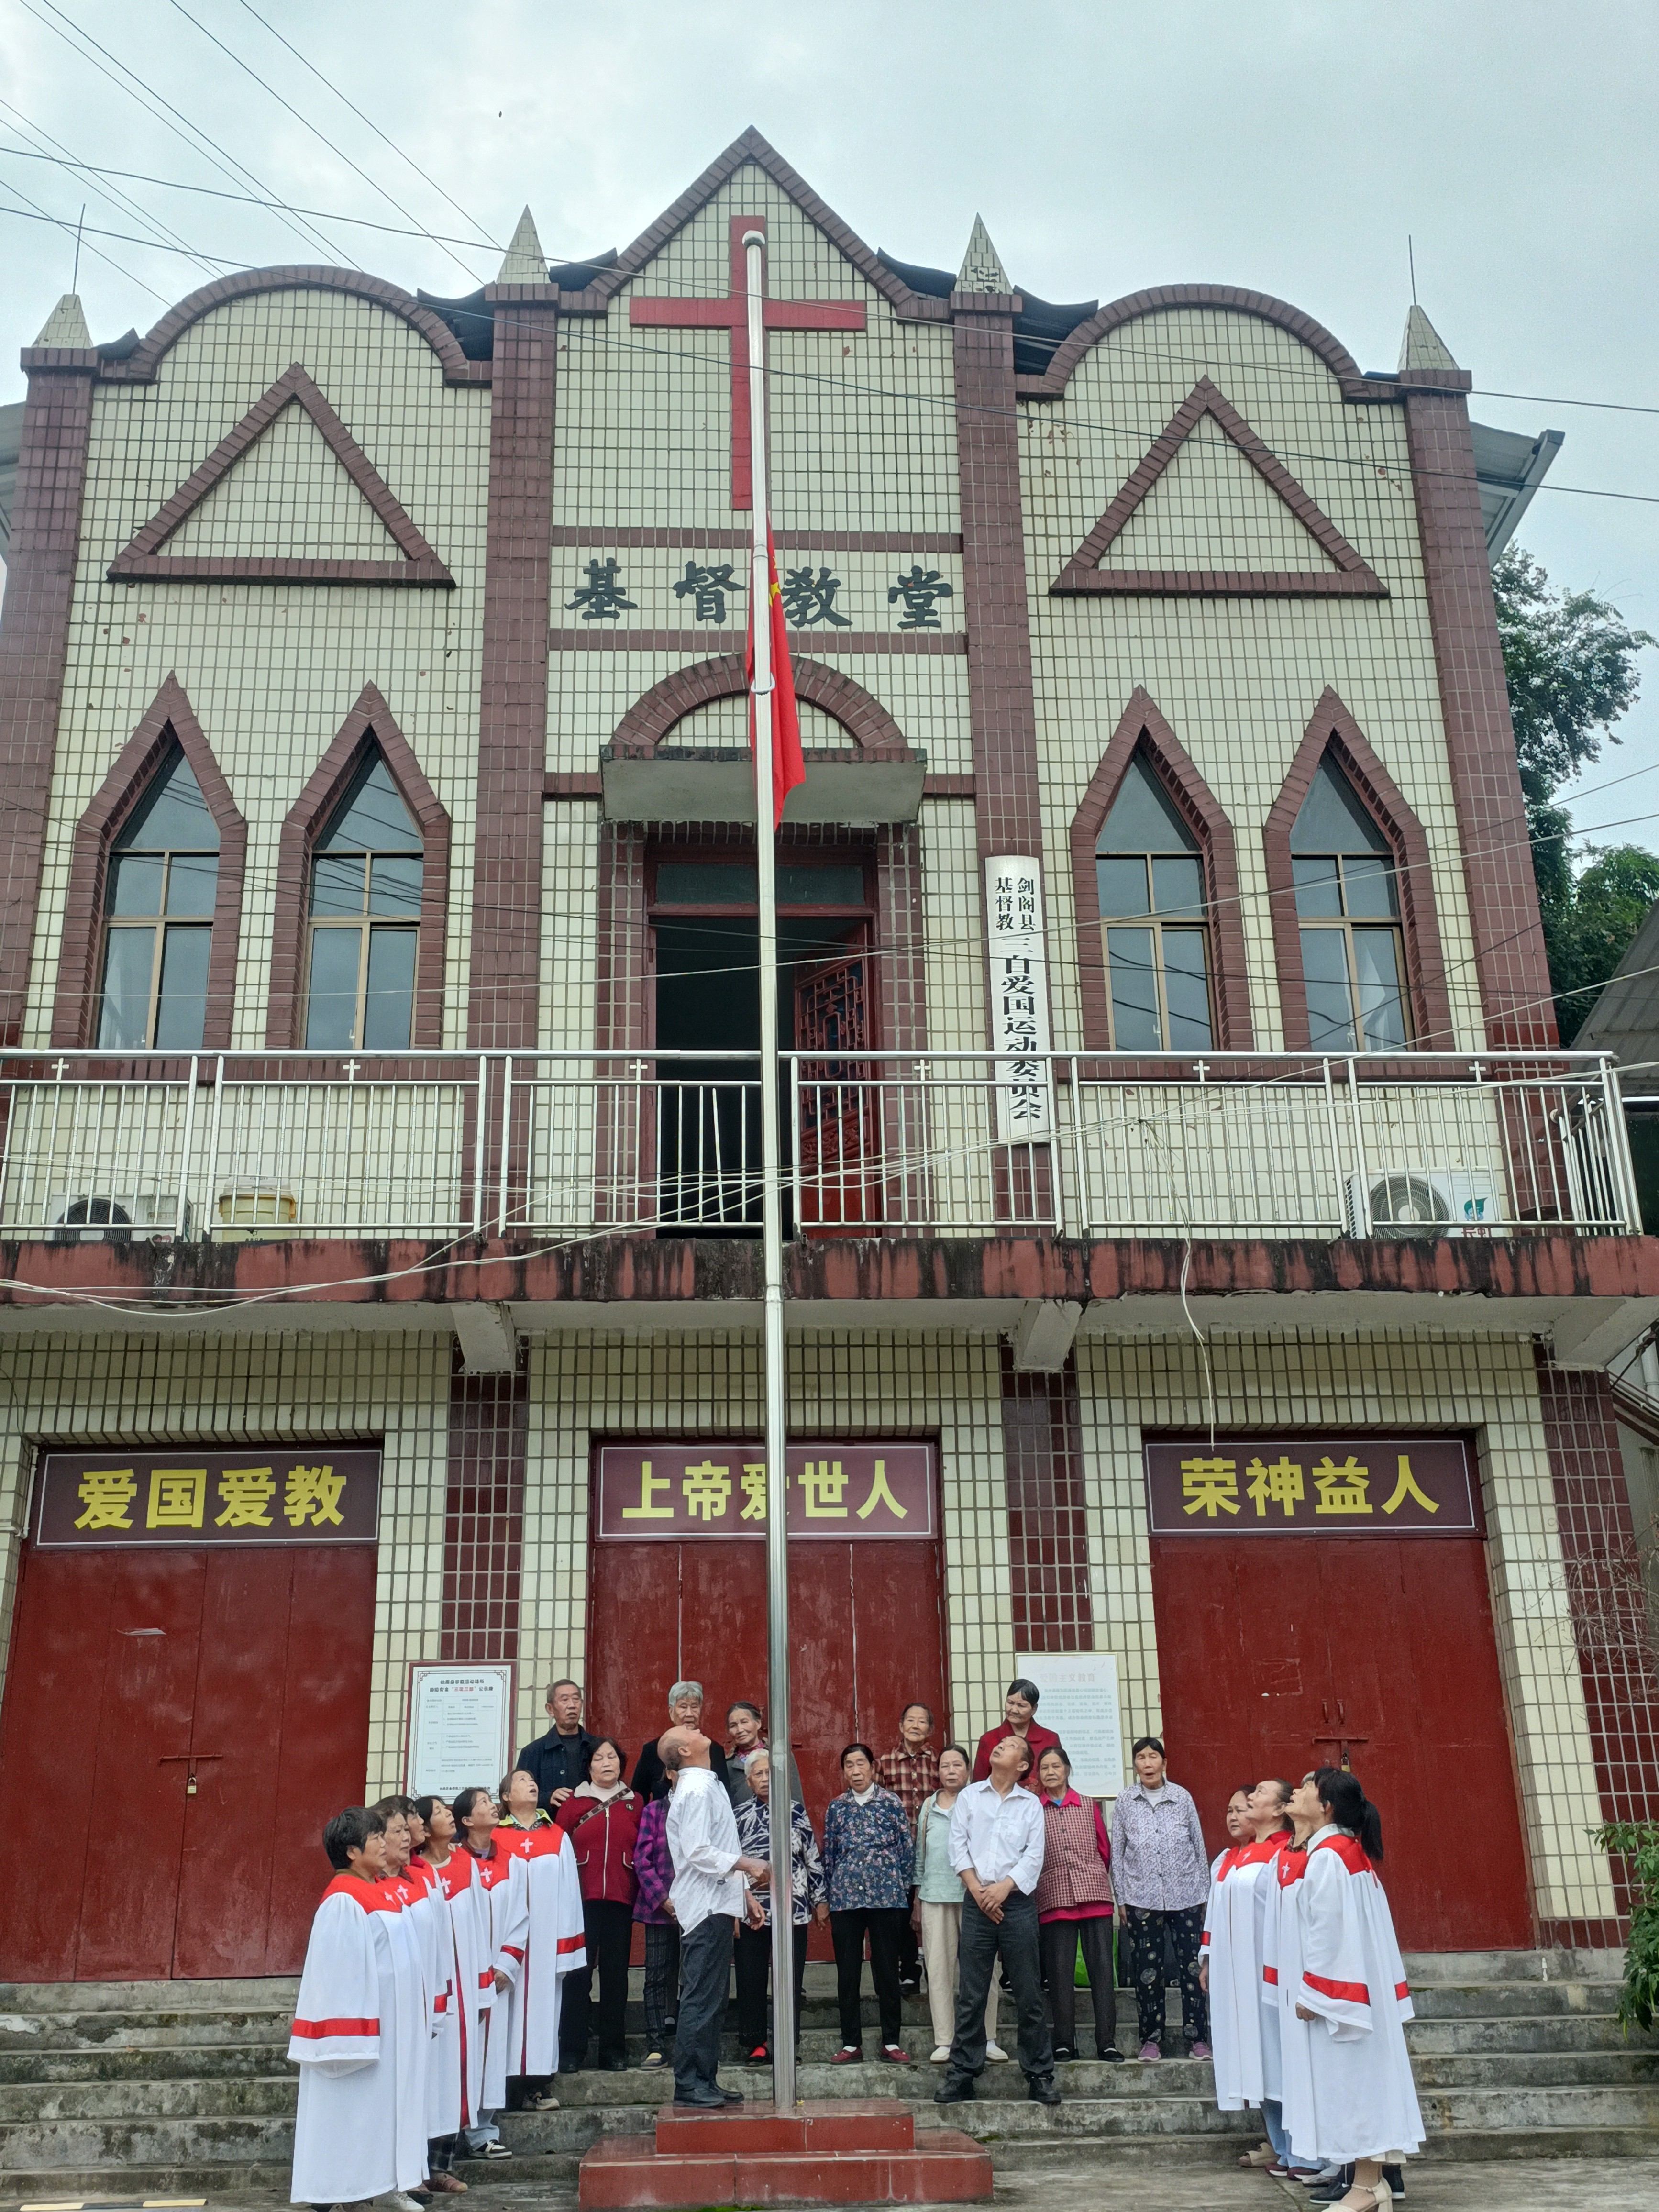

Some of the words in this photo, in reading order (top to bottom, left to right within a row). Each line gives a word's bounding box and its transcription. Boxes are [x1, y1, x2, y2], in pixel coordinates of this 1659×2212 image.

[995, 877, 1014, 930] 基督教
[1018, 877, 1036, 931] 剑阁县
[74, 1465, 347, 1530] 爱国爱教
[1180, 1454, 1440, 1517] 荣神益人
